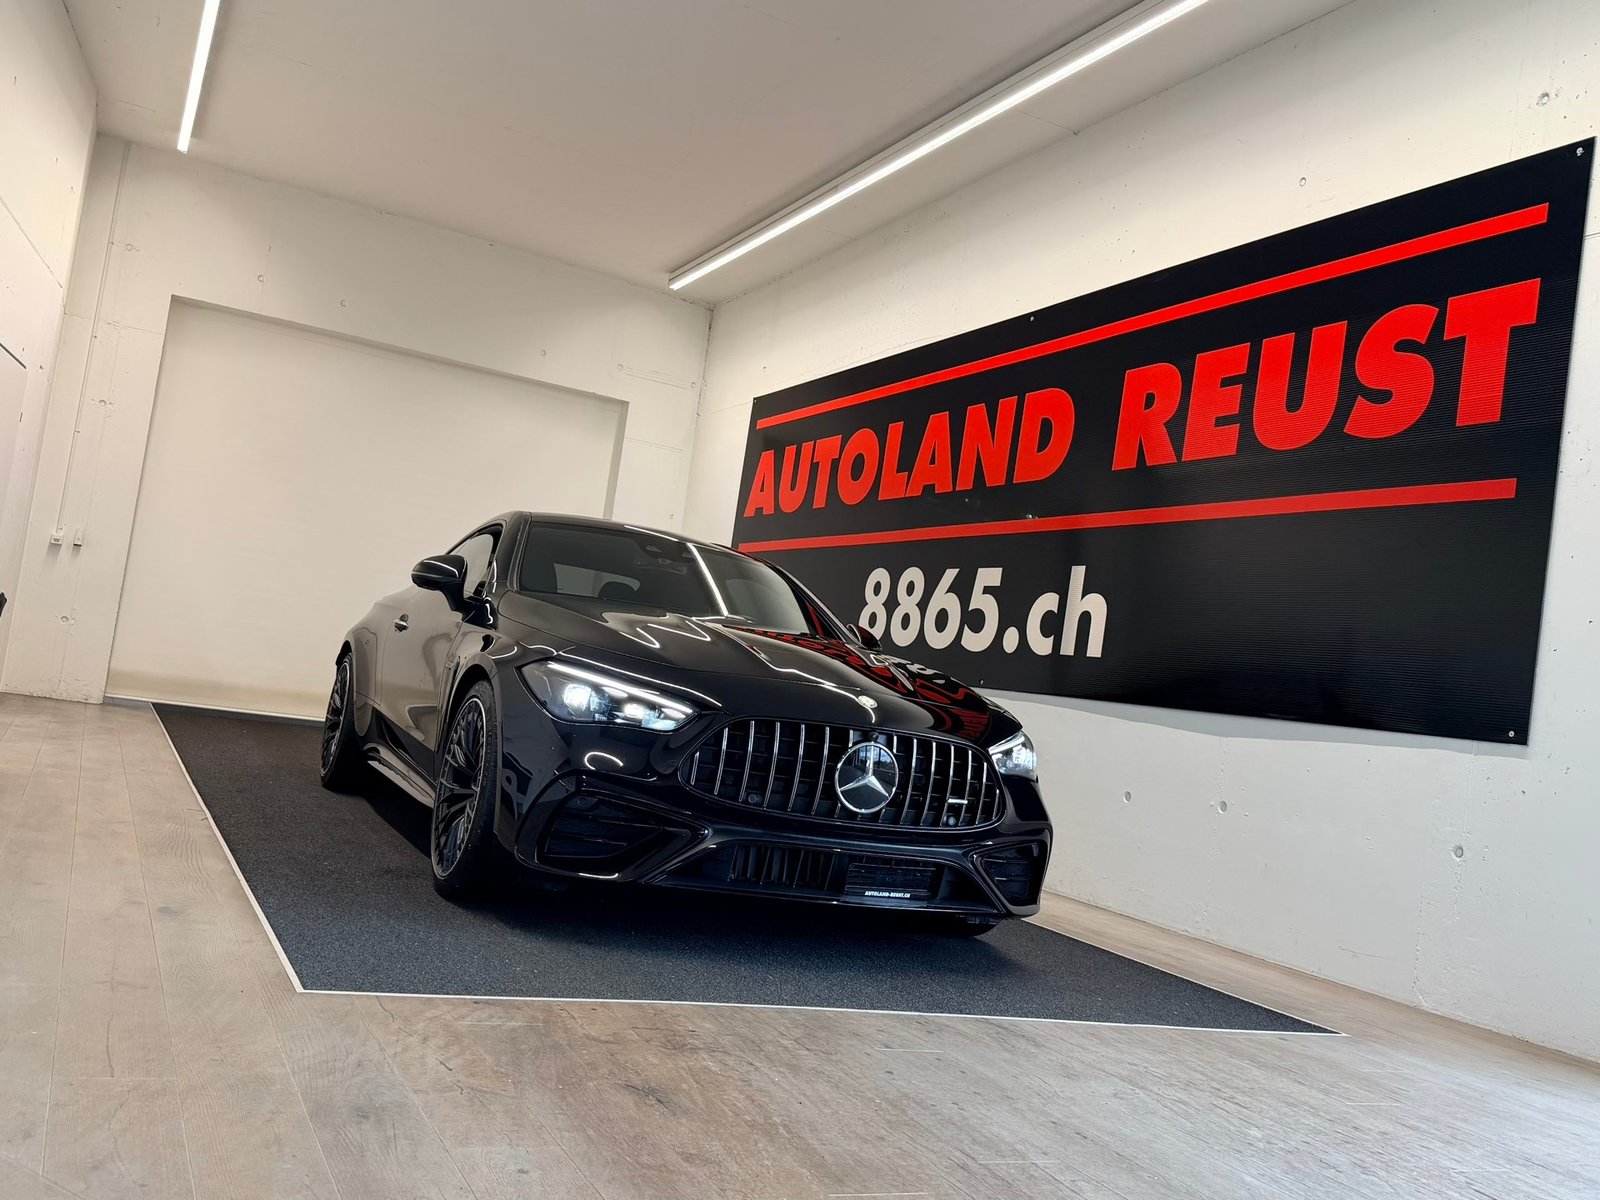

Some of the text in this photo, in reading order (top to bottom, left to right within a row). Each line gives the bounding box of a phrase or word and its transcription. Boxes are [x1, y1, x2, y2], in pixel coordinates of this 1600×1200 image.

[745, 278, 1540, 518] AUTOLAND REUST
[858, 565, 1108, 658] 8865.ch
